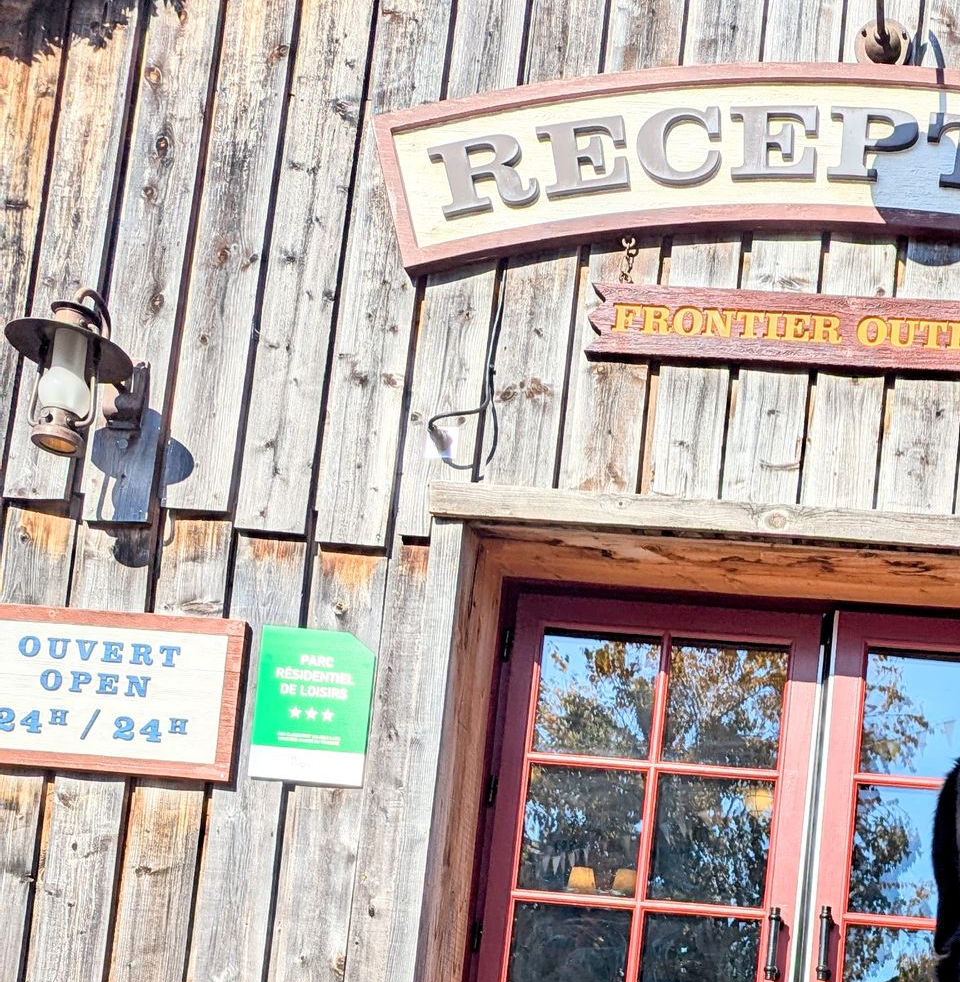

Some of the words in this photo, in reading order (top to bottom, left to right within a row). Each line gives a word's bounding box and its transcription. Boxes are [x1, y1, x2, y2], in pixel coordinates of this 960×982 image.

[611, 302, 842, 346] FRONTIER
[18, 635, 182, 667] OUVERT
[300, 653, 335, 668] PARC
[40, 668, 152, 698] OPEN
[275, 665, 355, 687] RÉSIDENTIEL
[280, 683, 297, 695] DE
[300, 684, 348, 700] LOISIRS
